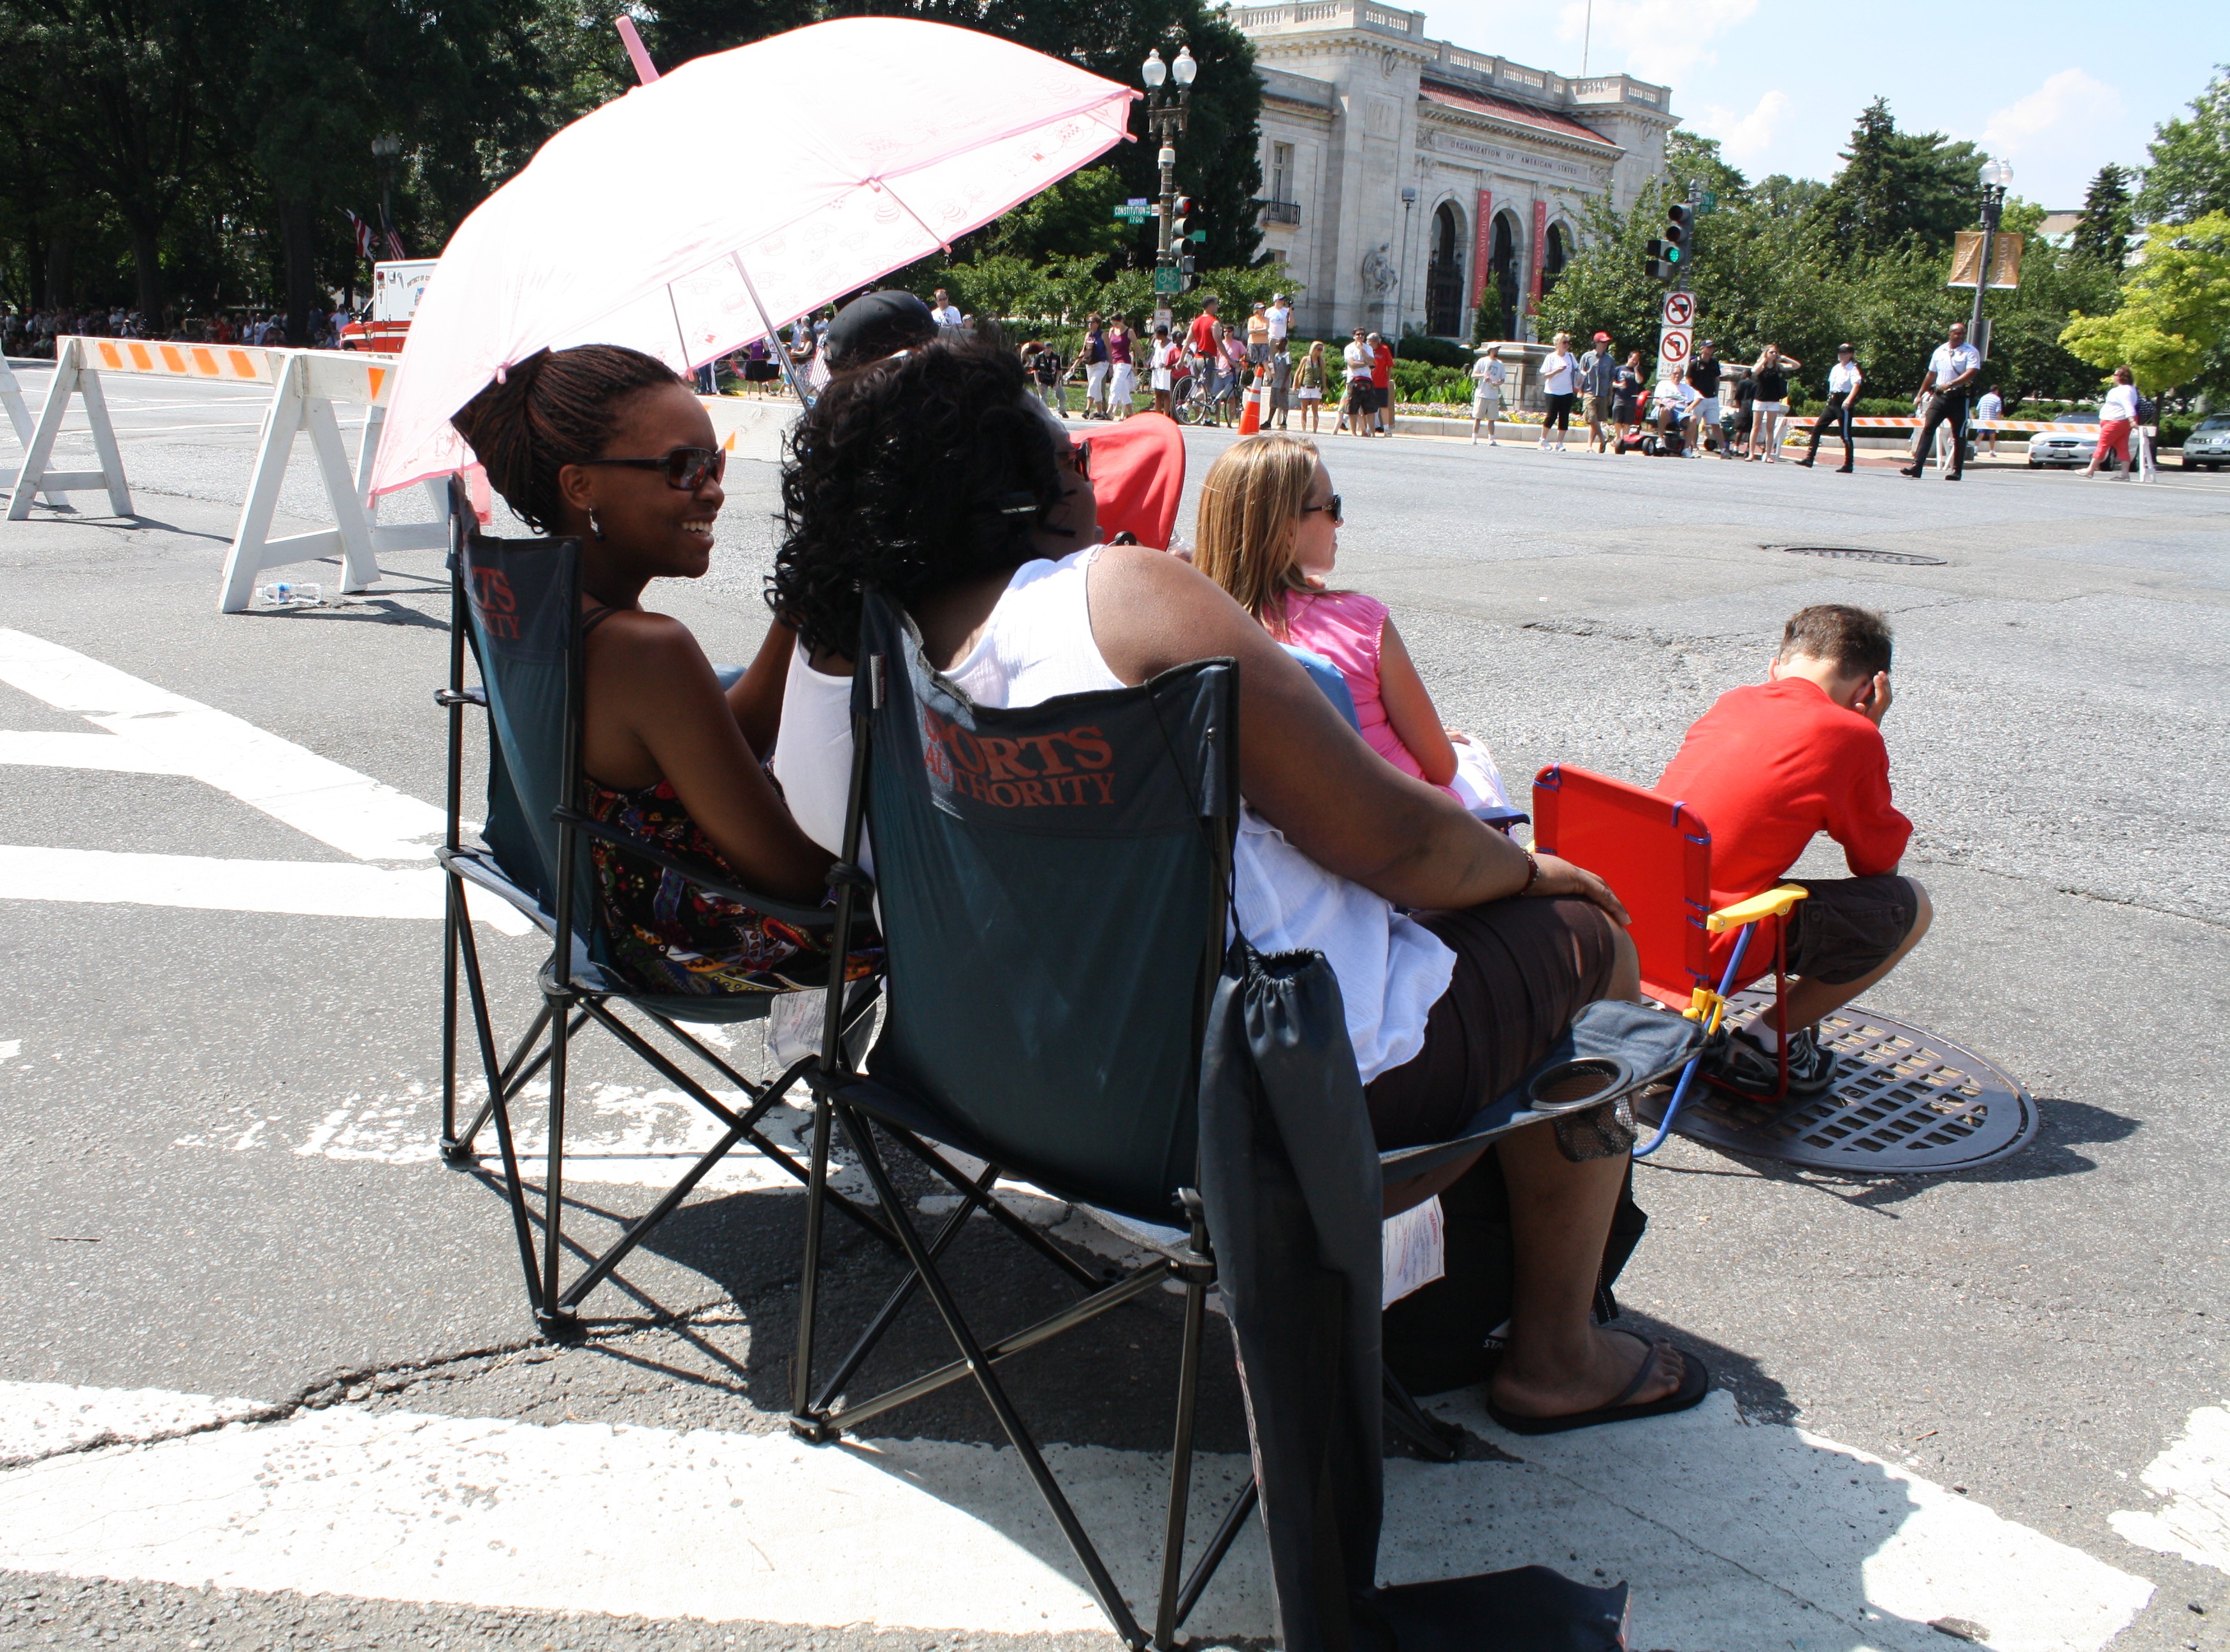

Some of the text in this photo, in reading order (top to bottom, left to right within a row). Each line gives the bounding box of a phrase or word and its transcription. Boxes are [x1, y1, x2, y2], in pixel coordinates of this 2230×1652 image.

[1451, 141, 1500, 157] ORGANIZATION
[1521, 157, 1553, 170] AMERICAN
[1558, 165, 1577, 175] STATES
[1115, 206, 1146, 215] CONSTITUTION
[1995, 236, 2009, 284] 100 YEARS
[1475, 274, 1484, 304] HOUSE
[923, 743, 1115, 808] AUTHORITY
[1429, 1212, 1438, 1245] WARNINGS
